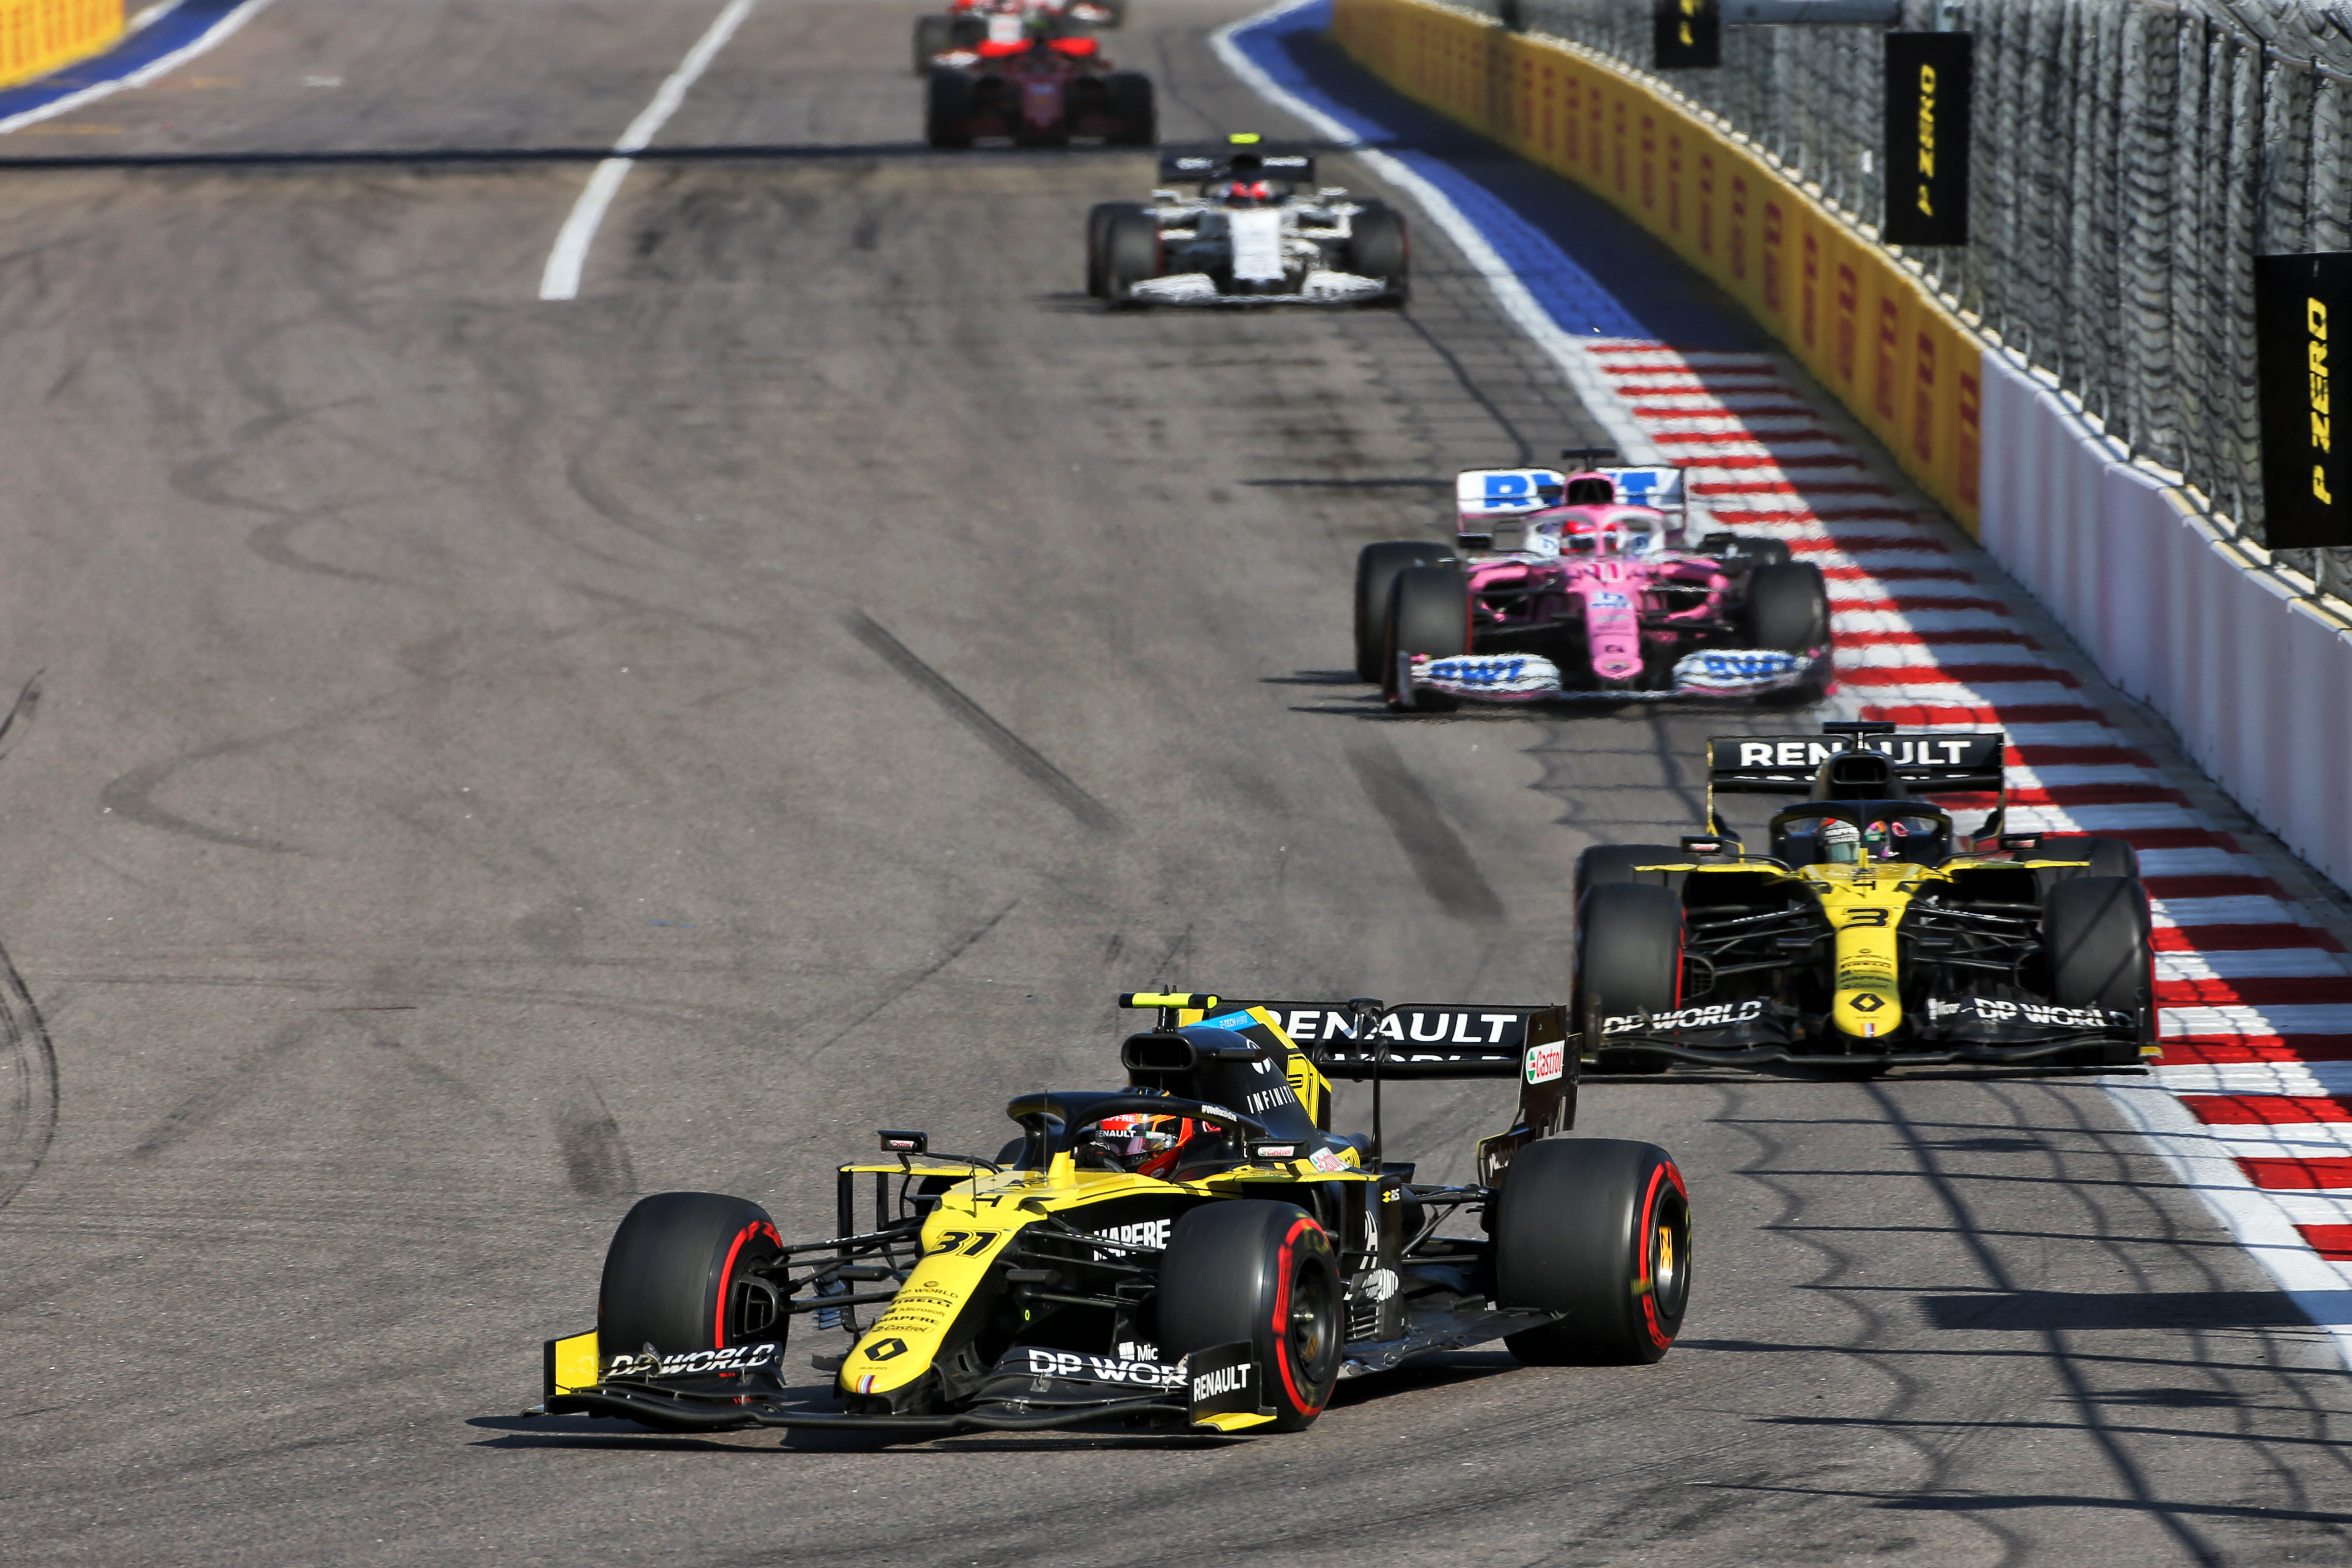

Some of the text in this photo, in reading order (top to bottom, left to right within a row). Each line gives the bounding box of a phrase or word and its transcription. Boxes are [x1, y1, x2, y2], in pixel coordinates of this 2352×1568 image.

[2308, 297, 2332, 505] P ZERO
[1740, 741, 1971, 766] RENULT
[1841, 907, 1894, 930] 3
[1651, 1001, 1762, 1029] WORLD
[1974, 998, 2135, 1028] DP WORLD
[1536, 1046, 1563, 1078] Castrol
[1247, 1085, 1295, 1114] INFINITI
[1267, 1148, 1292, 1156] Castrol
[924, 1229, 1002, 1259] 31
[914, 1288, 959, 1298] WORLD
[879, 1316, 941, 1327] MAPFRE
[899, 1307, 946, 1318] Microsoft
[658, 1344, 775, 1374] WORLD
[1029, 1349, 1083, 1375] DP
[1193, 1363, 1251, 1402] RENAULT
